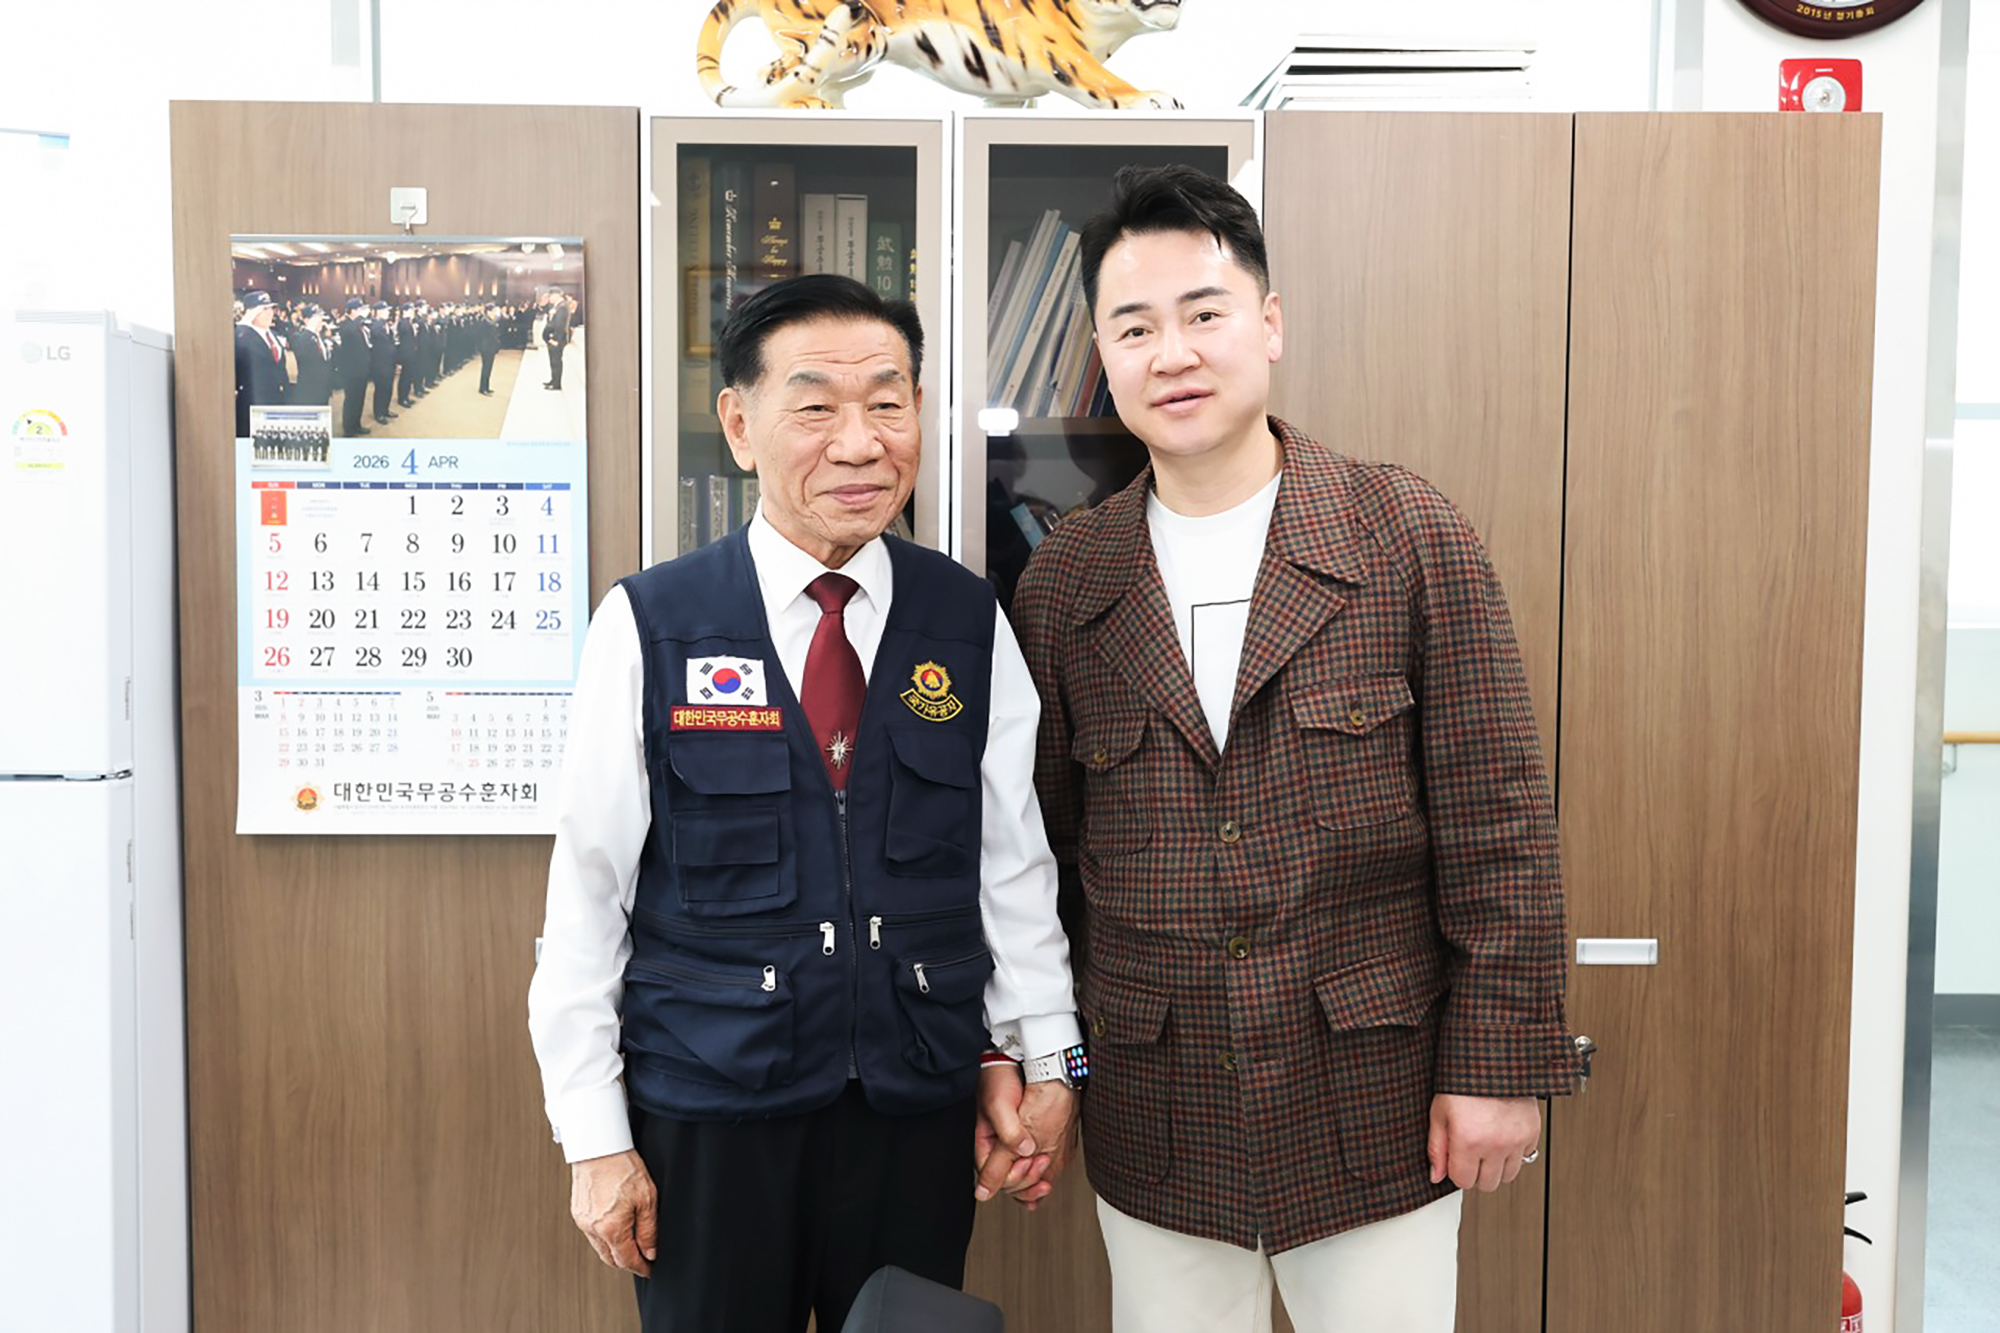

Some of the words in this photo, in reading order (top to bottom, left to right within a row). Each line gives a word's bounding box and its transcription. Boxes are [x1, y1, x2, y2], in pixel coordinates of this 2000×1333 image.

[1796, 4, 1832, 21] 2015년
[46, 345, 71, 361] LG
[36, 425, 43, 435] 2
[353, 455, 390, 469] 2026
[401, 448, 419, 475] 4
[428, 456, 459, 469] APR
[407, 496, 418, 515] 1
[451, 496, 464, 515] 2
[496, 496, 509, 515] 3
[540, 496, 554, 516] 4
[268, 533, 282, 552] 5
[314, 533, 328, 552] 6
[360, 533, 373, 552] 7
[406, 534, 420, 553] 8
[451, 534, 465, 552] 9
[492, 534, 517, 553] 10
[536, 534, 560, 554] 11
[264, 571, 289, 591] 12
[309, 571, 335, 591] 13
[356, 572, 380, 591] 14
[402, 572, 426, 592] 15
[448, 572, 472, 592] 16
[493, 572, 516, 592] 17
[537, 572, 562, 592] 18
[265, 609, 290, 629] 19
[309, 610, 336, 628] 20
[354, 609, 380, 629] 21
[400, 610, 426, 629] 22
[445, 610, 472, 629] 23
[491, 610, 518, 629] 24
[535, 611, 562, 629] 25
[264, 647, 291, 666] 26
[309, 647, 336, 666] 27
[355, 647, 382, 666] 28
[401, 648, 428, 666] 29
[446, 648, 473, 666] 30
[254, 690, 263, 702] 3
[426, 691, 434, 703] 5
[907, 693, 957, 718] 국가유공자
[673, 709, 781, 727] 대한민국무공수훈자회
[333, 782, 538, 803] 대한민국무공수훈자회
